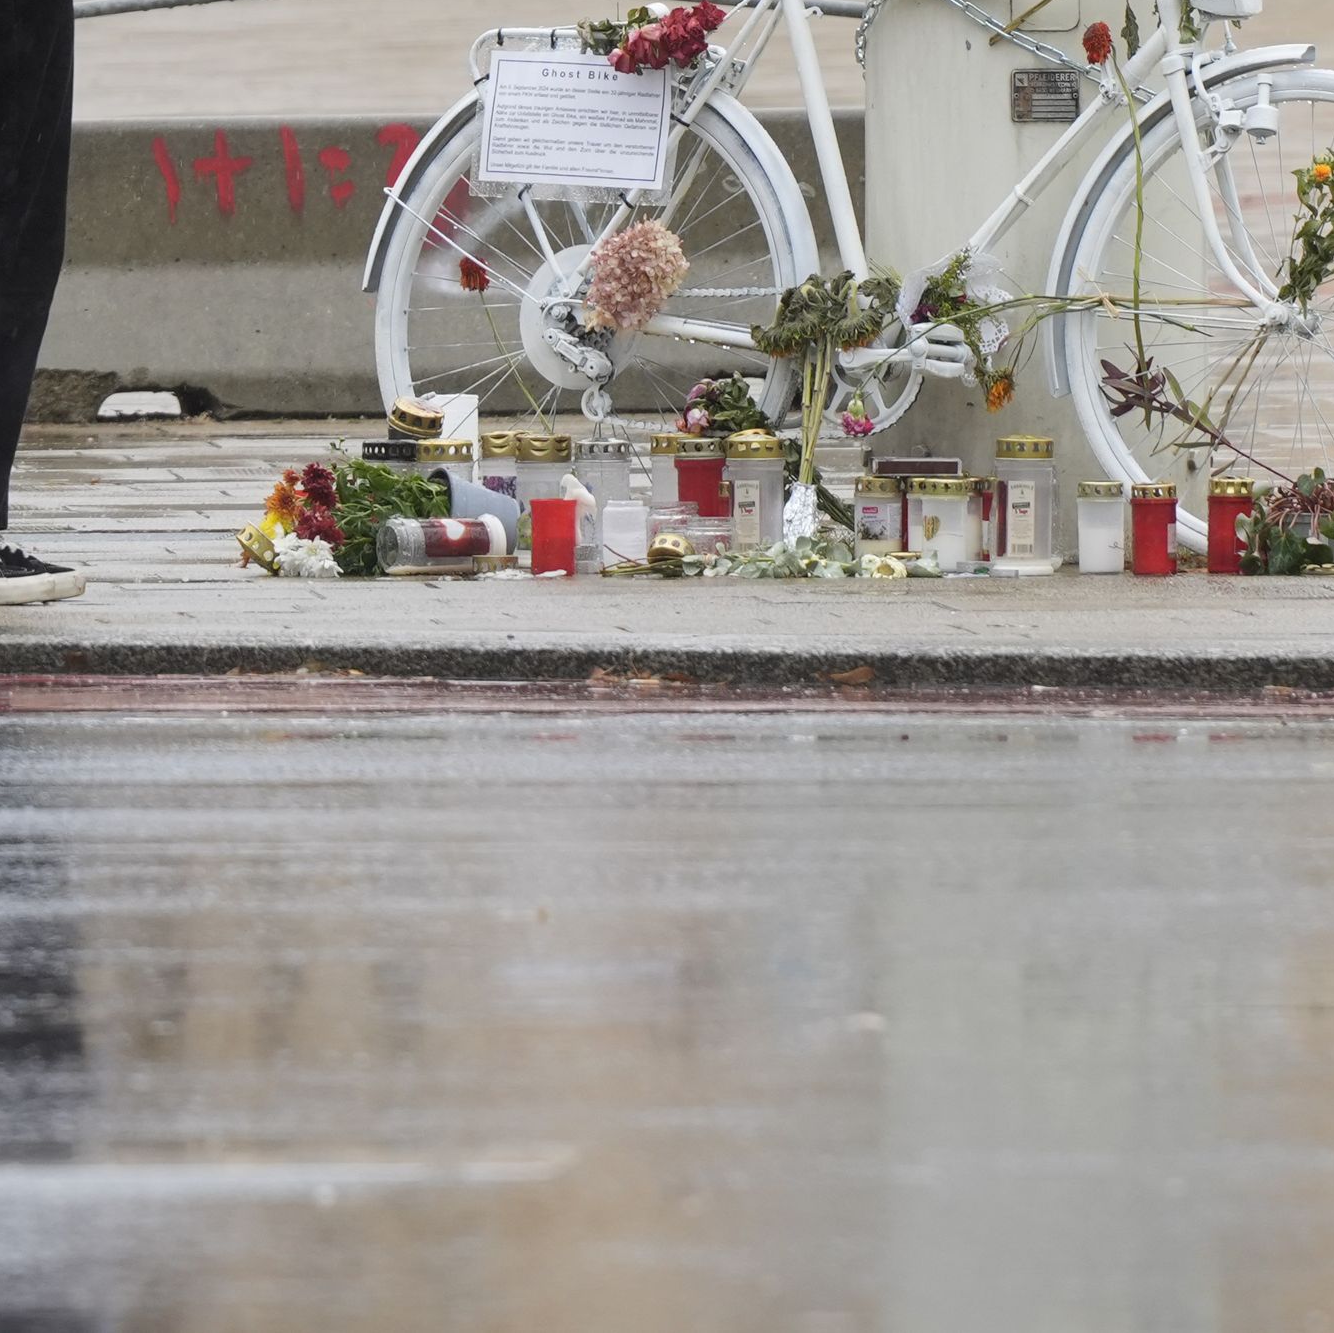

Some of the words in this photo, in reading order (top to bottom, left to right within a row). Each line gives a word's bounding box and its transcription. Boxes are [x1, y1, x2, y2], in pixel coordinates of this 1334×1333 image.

[542, 68, 580, 79] Ghost
[588, 70, 618, 81] Bike
[1028, 72, 1076, 82] PFLEIDERER
